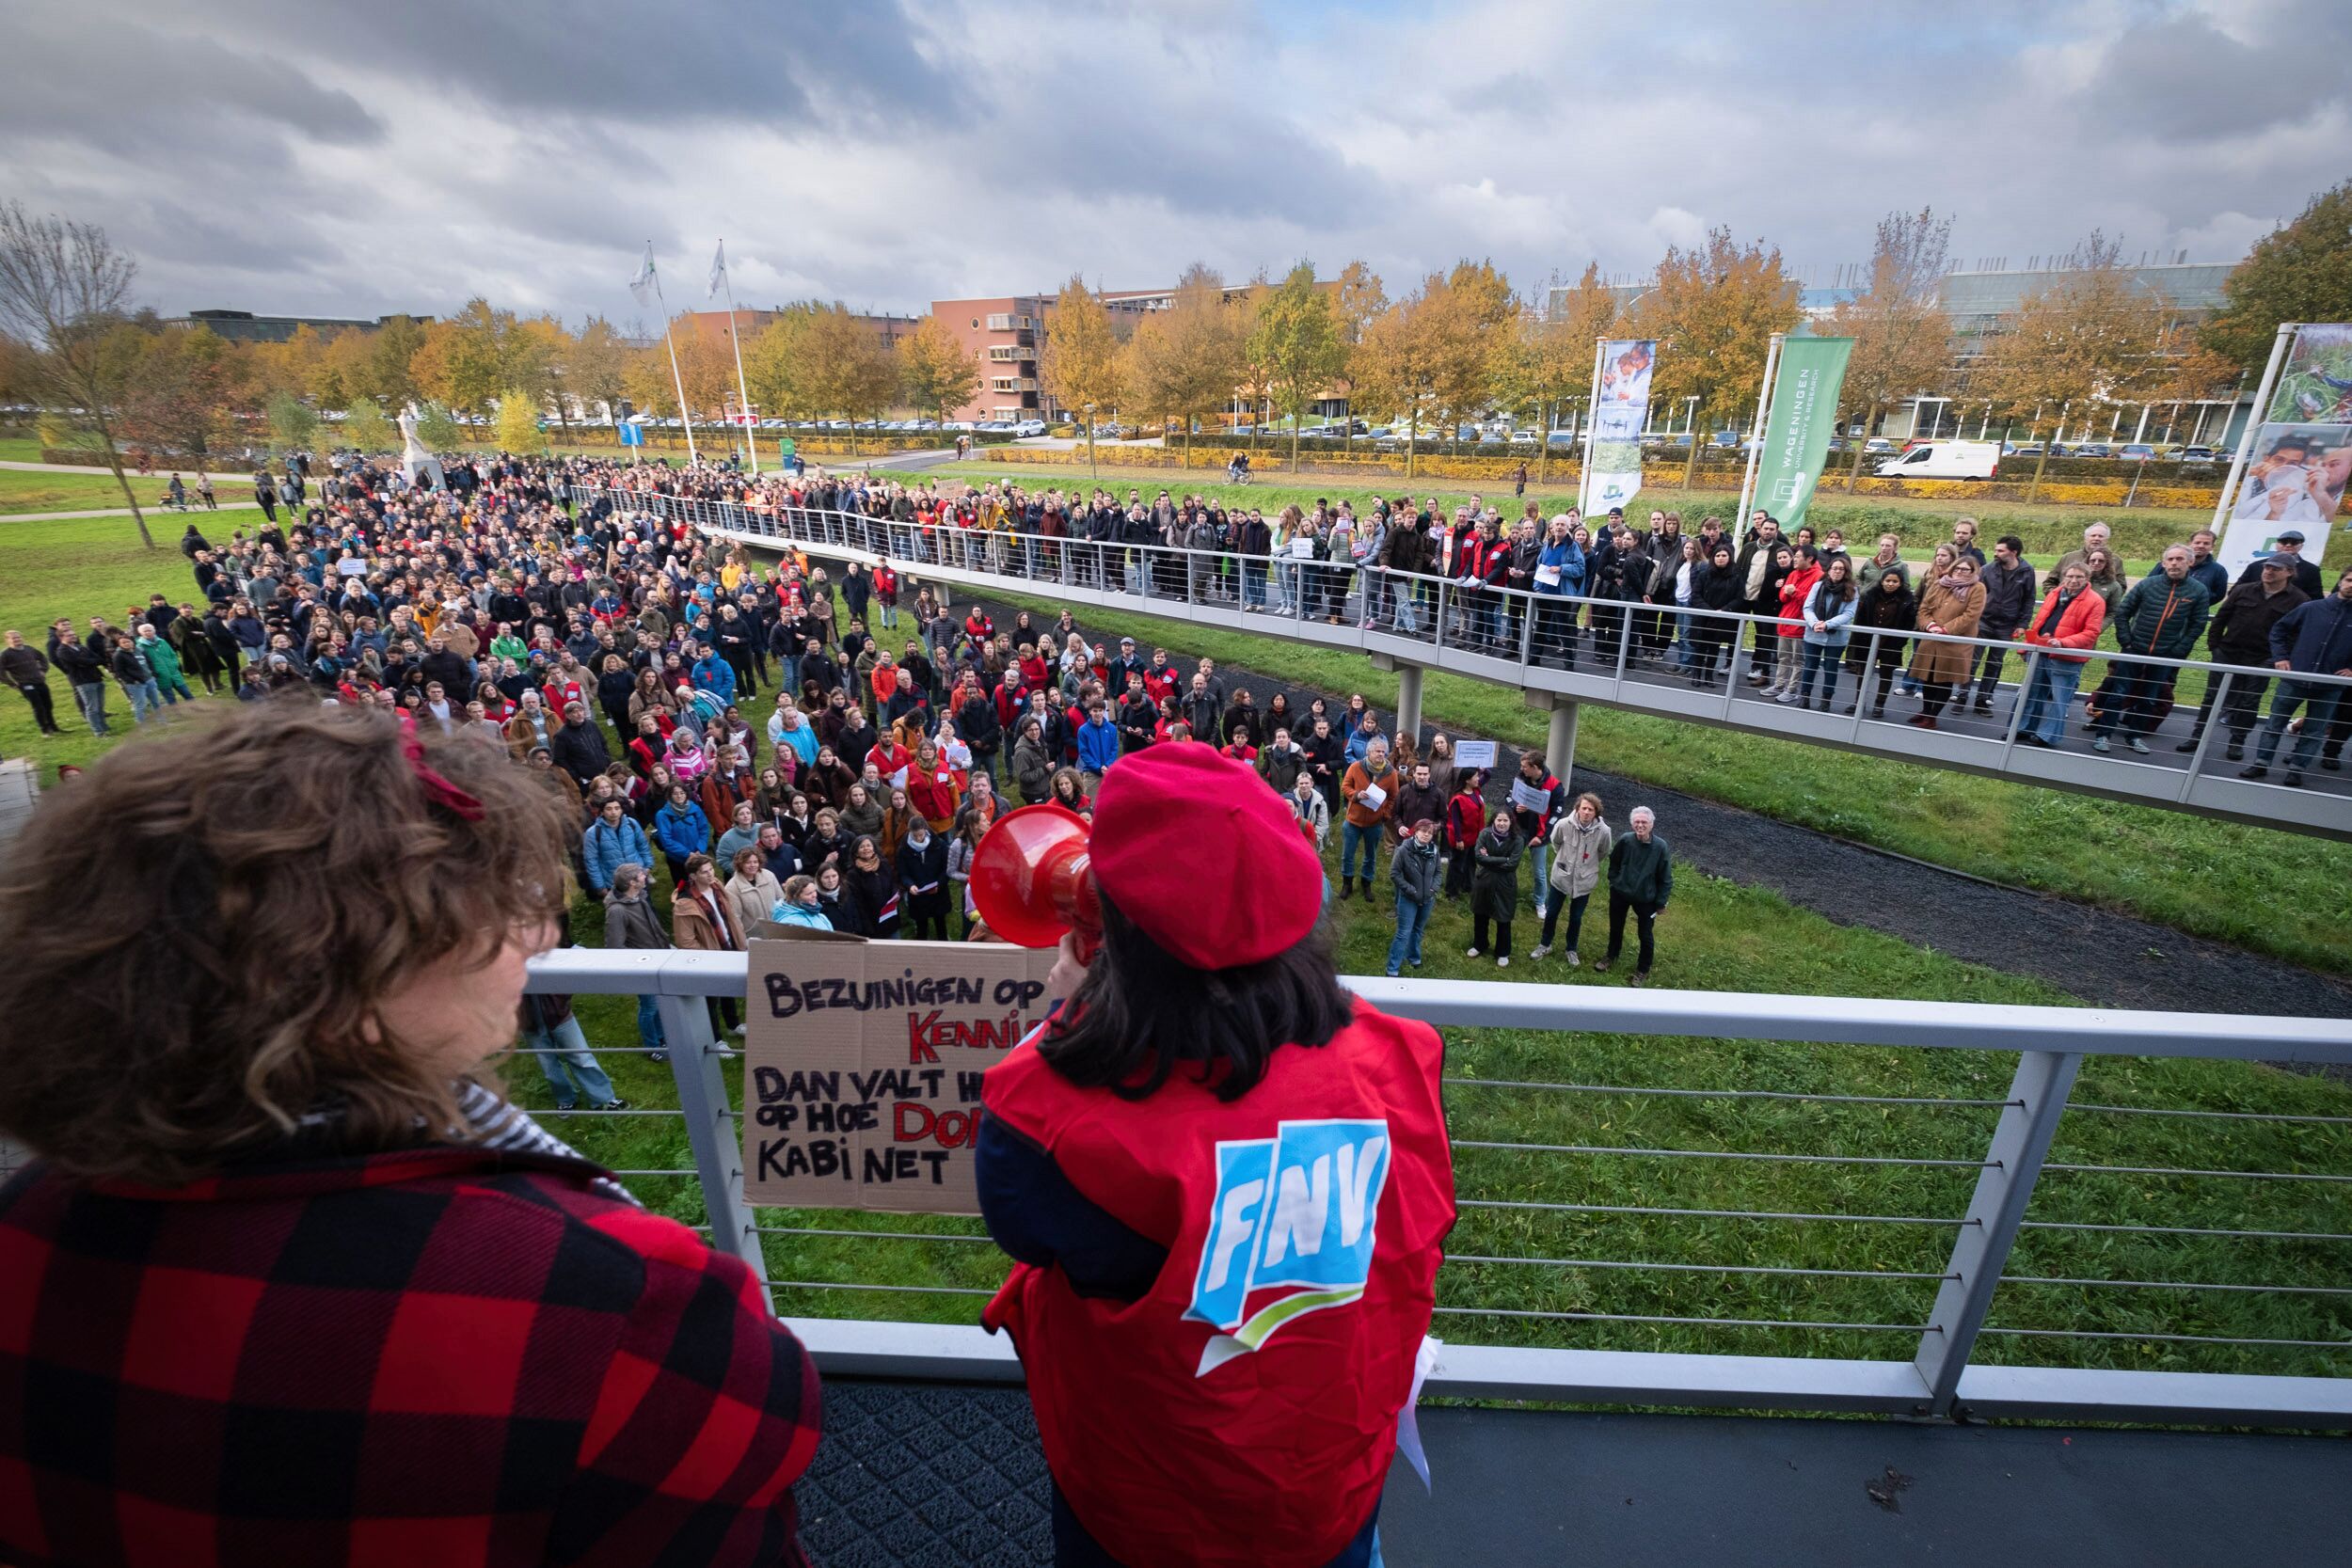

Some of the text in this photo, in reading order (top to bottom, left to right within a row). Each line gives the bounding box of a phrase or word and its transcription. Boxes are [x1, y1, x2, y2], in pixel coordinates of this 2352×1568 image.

[1783, 369, 1809, 467] WAGENINGEN
[1794, 423, 1809, 468] UNIVERSITY
[1805, 369, 1820, 413] RESEARCH
[993, 979, 1044, 1008] OP
[754, 1067, 840, 1103] DAN
[849, 1069, 945, 1103] VALT
[755, 1104, 799, 1131] OP
[806, 1102, 879, 1132] HOE
[1205, 1136, 1385, 1293] FNV
